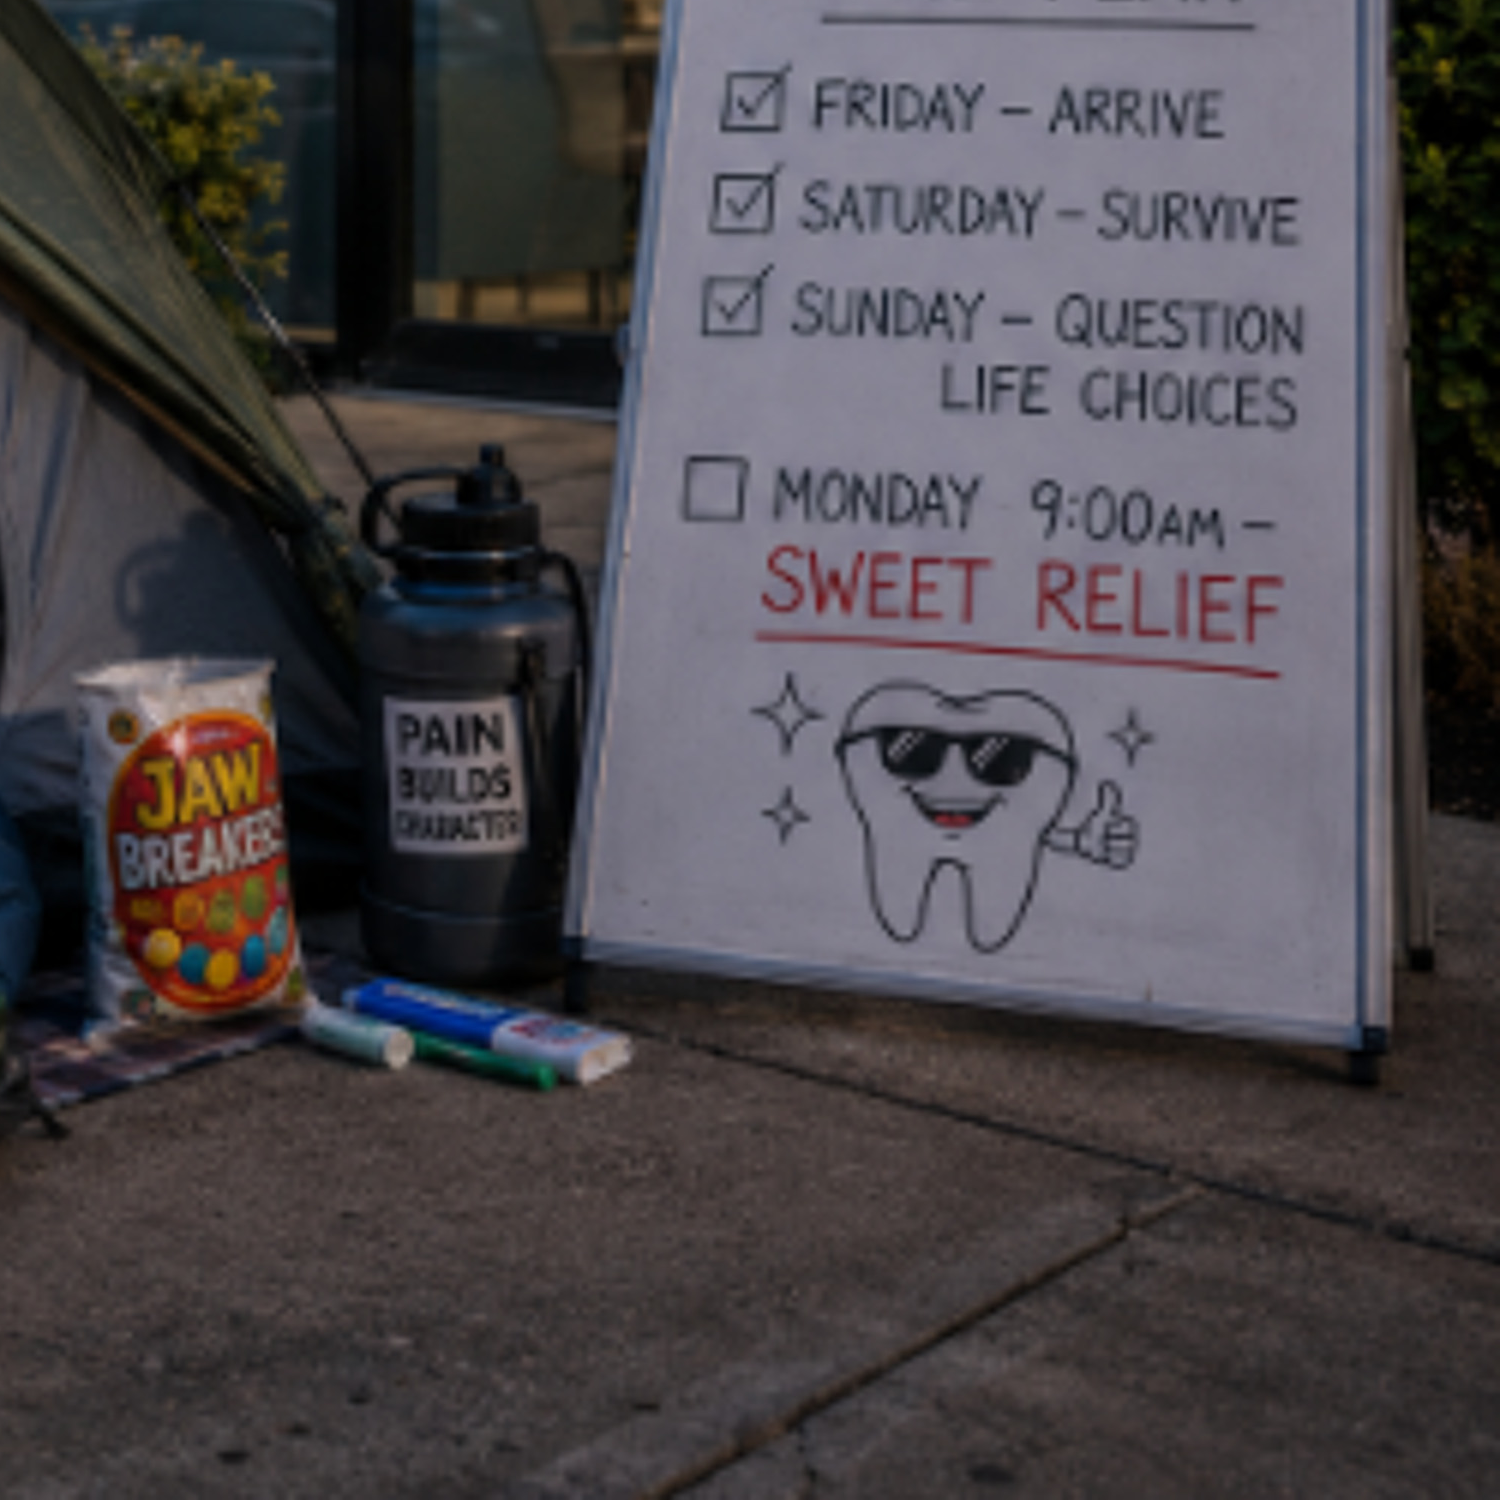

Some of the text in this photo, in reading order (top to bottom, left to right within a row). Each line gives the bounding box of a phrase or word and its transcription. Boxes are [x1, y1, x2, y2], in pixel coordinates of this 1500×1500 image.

[813, 78, 985, 134] FRIDAY
[1049, 87, 1226, 139] ARRIVE
[798, 180, 1043, 238] SATURDAY
[1098, 191, 1298, 246] SURVIVE
[790, 281, 985, 342] SUNDAY
[1055, 293, 1304, 356] QUESTION
[939, 364, 1298, 430] LIFE CHOICES
[773, 467, 981, 531] MONDAY
[1031, 480, 1226, 550] 9:00AM
[759, 544, 1283, 645] SWEET RELIEF
[395, 713, 504, 757] PAIN
[136, 742, 261, 830] JAW
[396, 763, 513, 804] BUILDS
